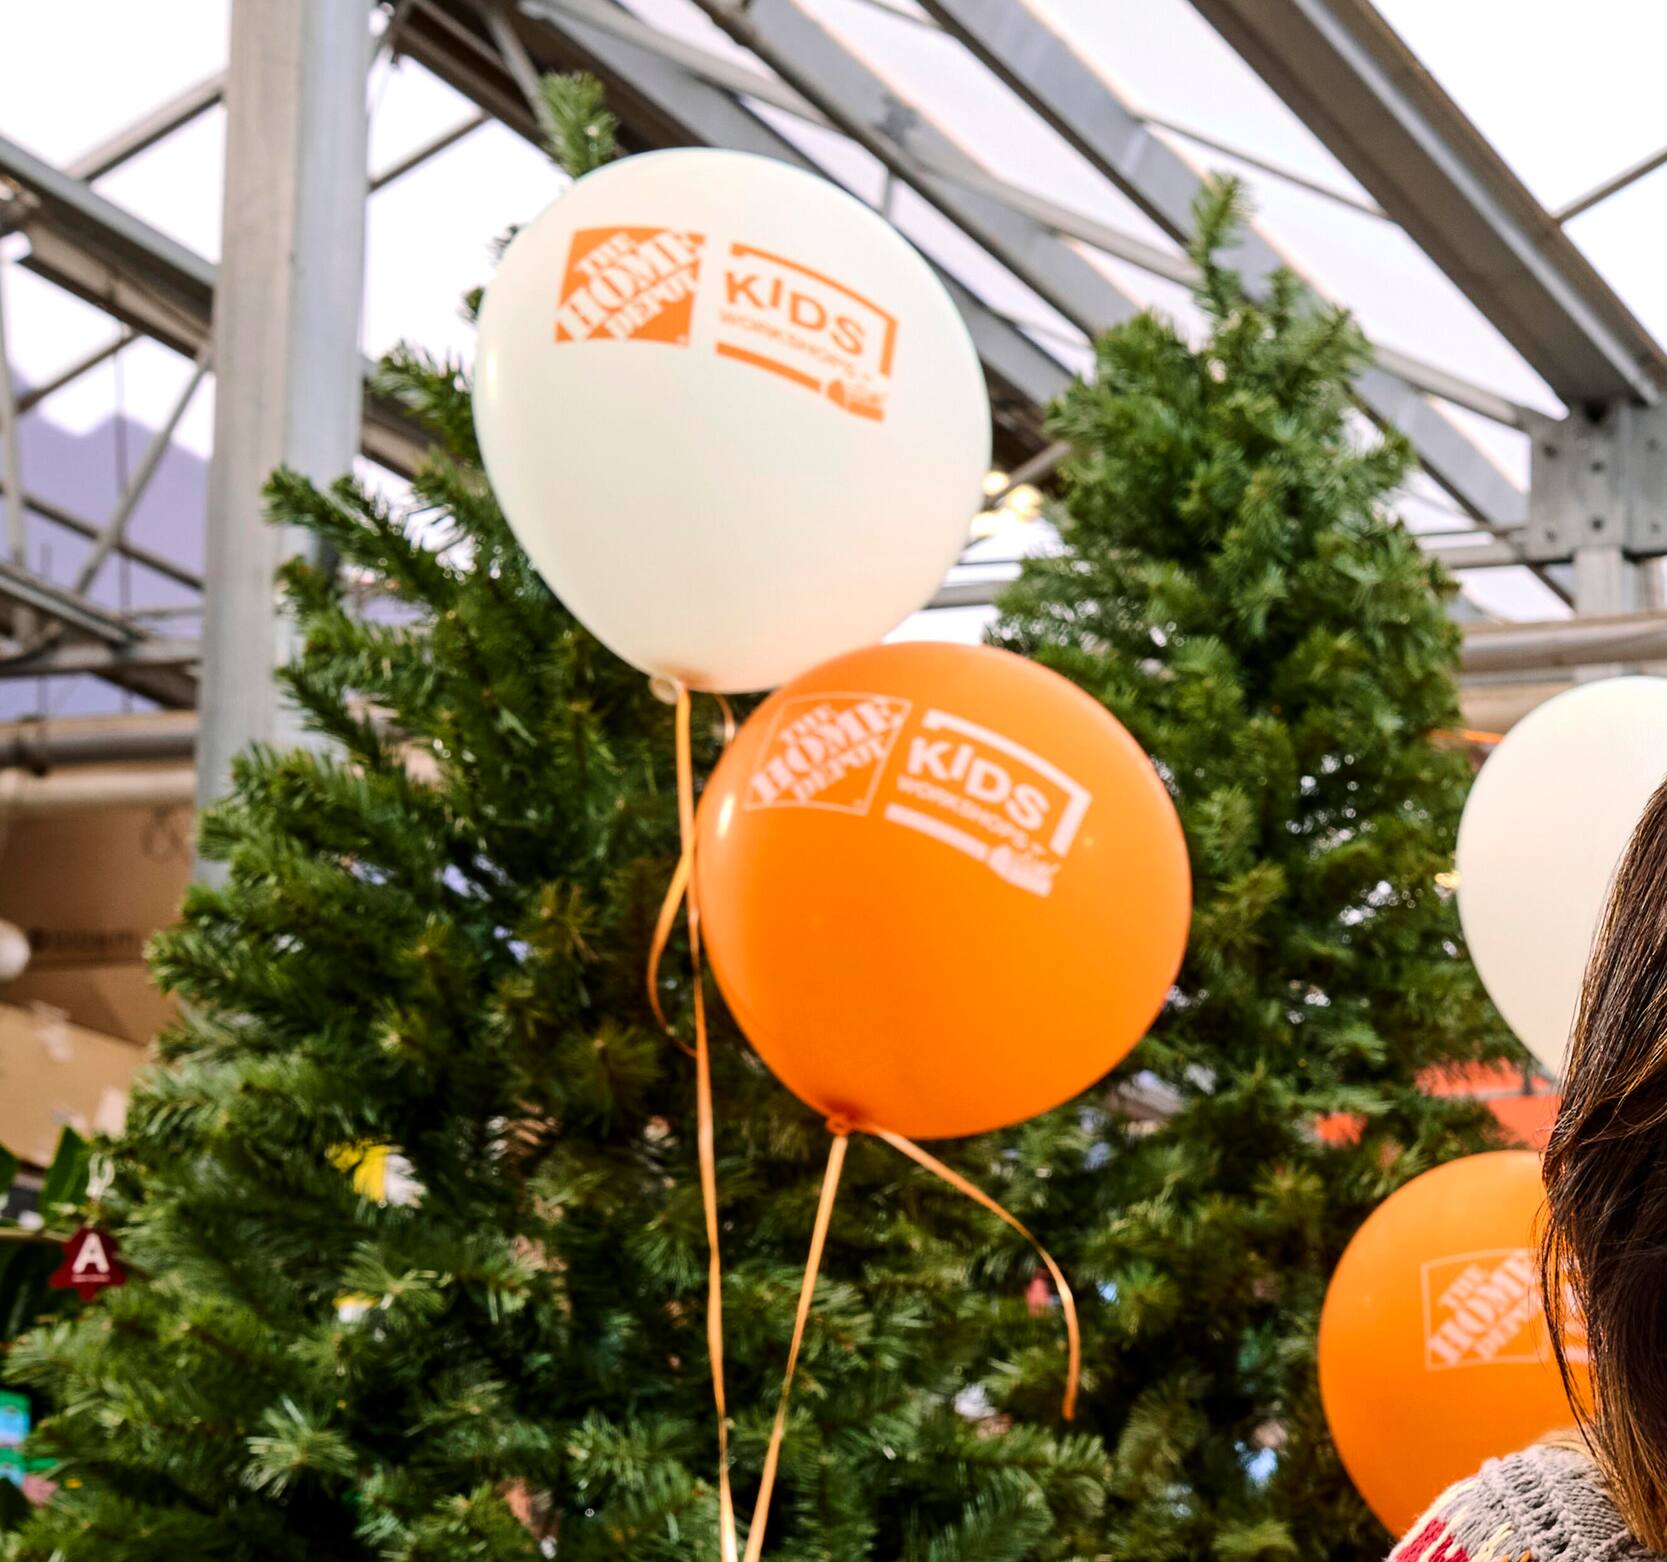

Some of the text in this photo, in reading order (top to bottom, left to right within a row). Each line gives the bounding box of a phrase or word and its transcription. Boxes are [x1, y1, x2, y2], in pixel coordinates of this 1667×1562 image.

[556, 231, 703, 342] HOME
[574, 231, 638, 272] THE
[603, 266, 699, 340] DEPOT
[725, 270, 865, 356] KIDS
[752, 696, 904, 804] HOME
[779, 705, 838, 745] THE
[792, 736, 886, 802] DEPOT
[907, 737, 1051, 831] KIDS
